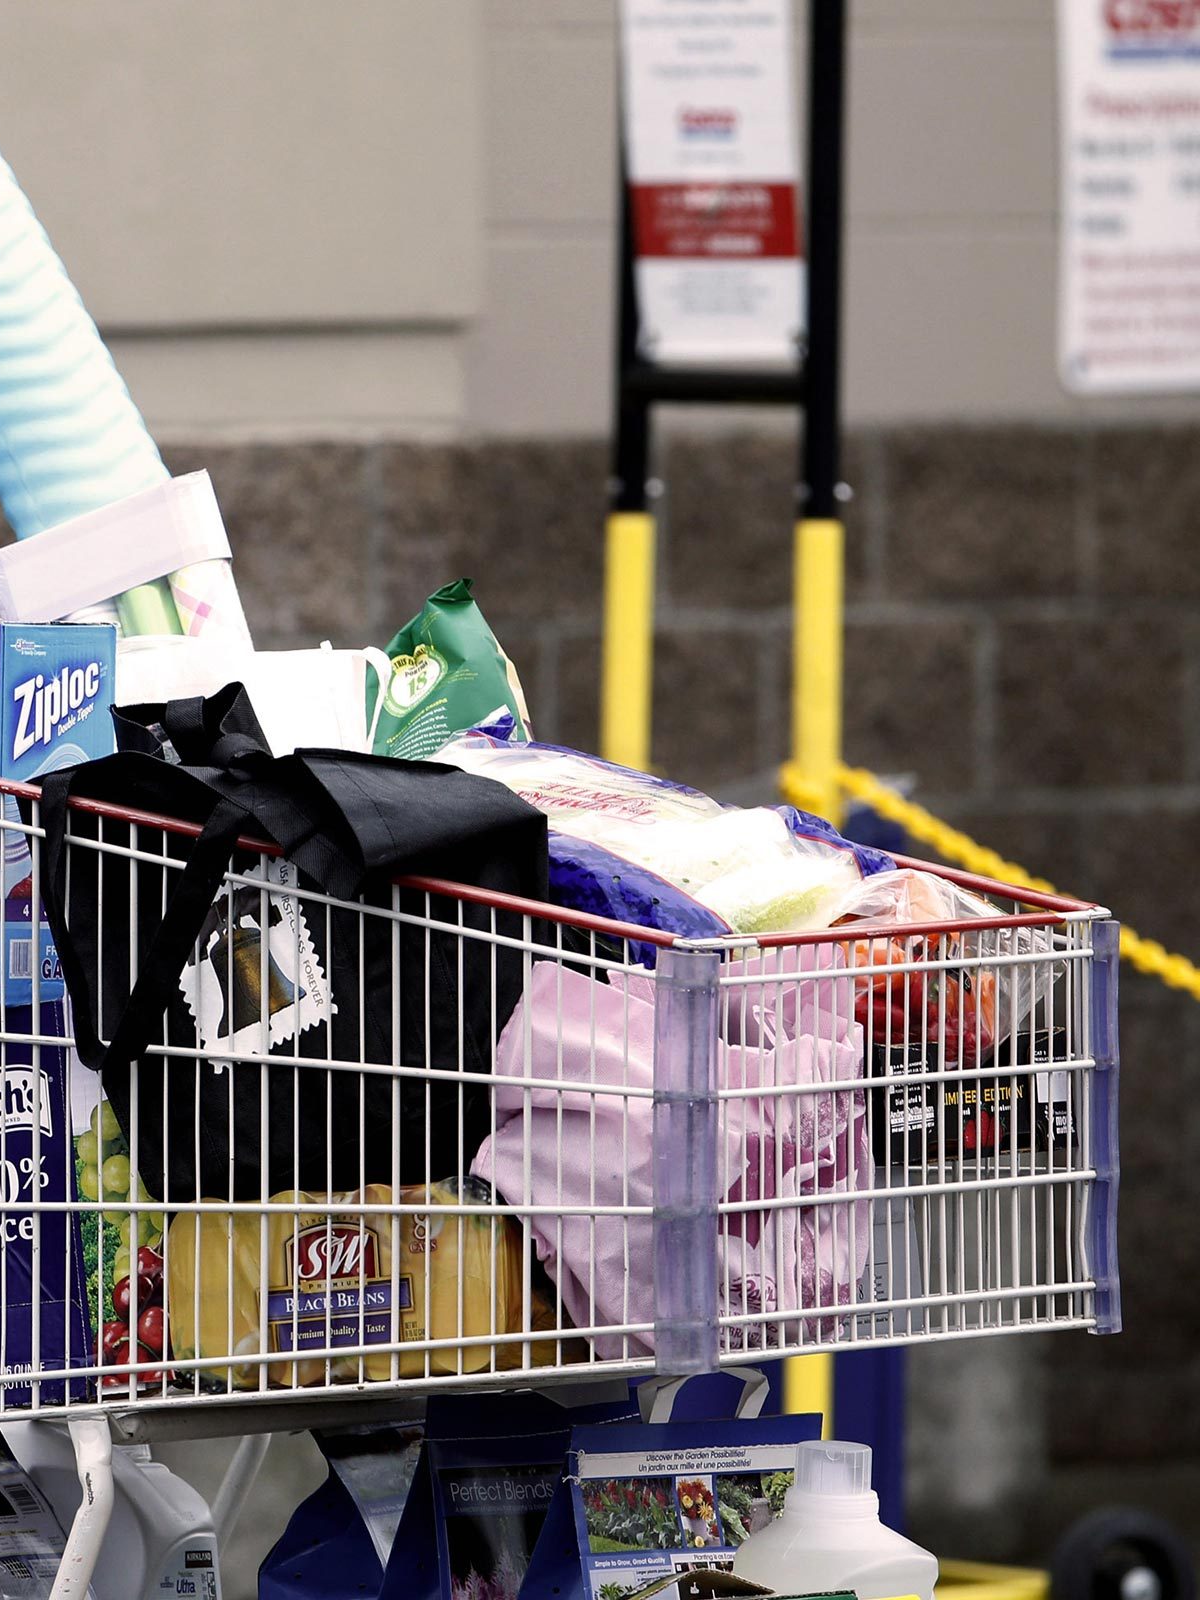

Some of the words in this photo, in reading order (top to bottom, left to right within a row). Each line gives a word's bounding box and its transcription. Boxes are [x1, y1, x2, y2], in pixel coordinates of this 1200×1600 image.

[13, 662, 99, 761] Ziploc
[279, 864, 289, 886] USA
[23, 904, 29, 917] 4
[302, 959, 324, 1007] FOREVER
[4, 1117, 21, 1126] WNED
[414, 1213, 431, 1240] 8
[409, 1240, 437, 1253] CAS
[308, 1279, 361, 1291] PRMIUM
[337, 1292, 386, 1308] BEANS
[290, 1329, 325, 1341] Pemium
[366, 1323, 386, 1335] Taste
[14, 1361, 45, 1375] OUNE
[646, 1453, 673, 1462] Discover
[685, 1451, 709, 1460] Garden
[638, 1464, 647, 1472] Un
[648, 1463, 665, 1472] jardin
[666, 1463, 678, 1471] aux
[680, 1462, 695, 1470] mille
[696, 1461, 703, 1469] et
[450, 1481, 501, 1502] Perfect
[503, 1479, 555, 1500] Blends
[595, 1560, 610, 1568] Simple
[617, 1559, 632, 1567] Grow,
[648, 1557, 666, 1566] Quality
[176, 1578, 196, 1594] Ultra
